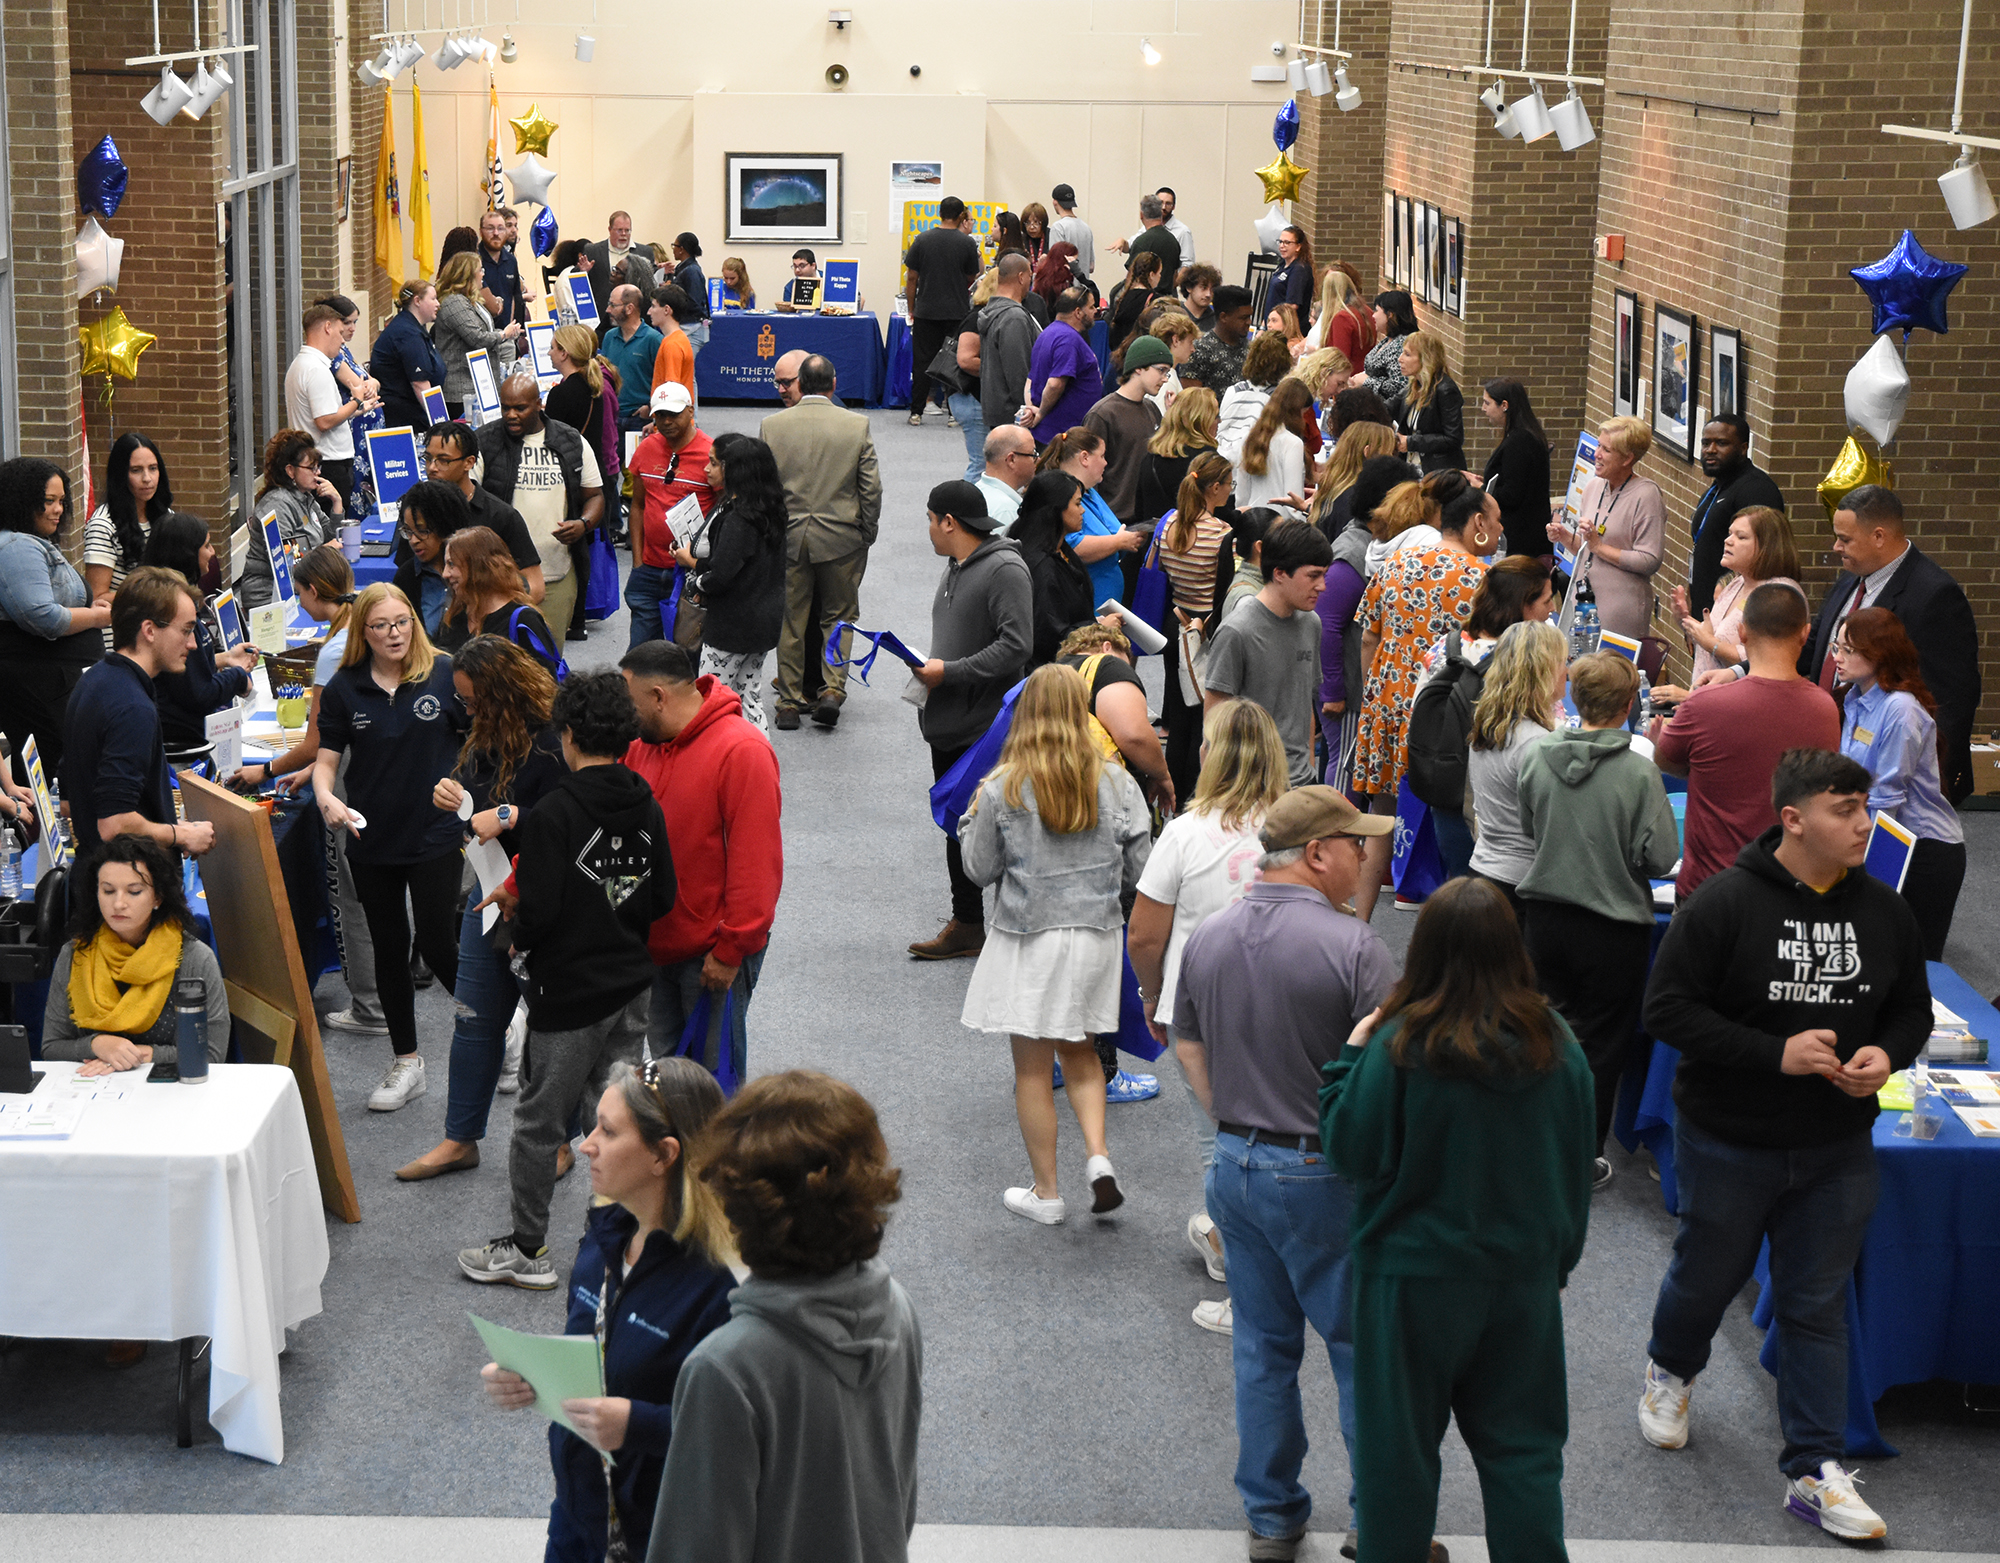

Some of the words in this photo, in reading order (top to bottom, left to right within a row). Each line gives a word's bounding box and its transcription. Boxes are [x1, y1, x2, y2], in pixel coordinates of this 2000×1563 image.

[720, 366, 738, 375] PHI
[741, 367, 775, 376] THETA
[384, 460, 406, 469] Military
[385, 469, 409, 479] Services
[1794, 961, 1813, 982] IT
